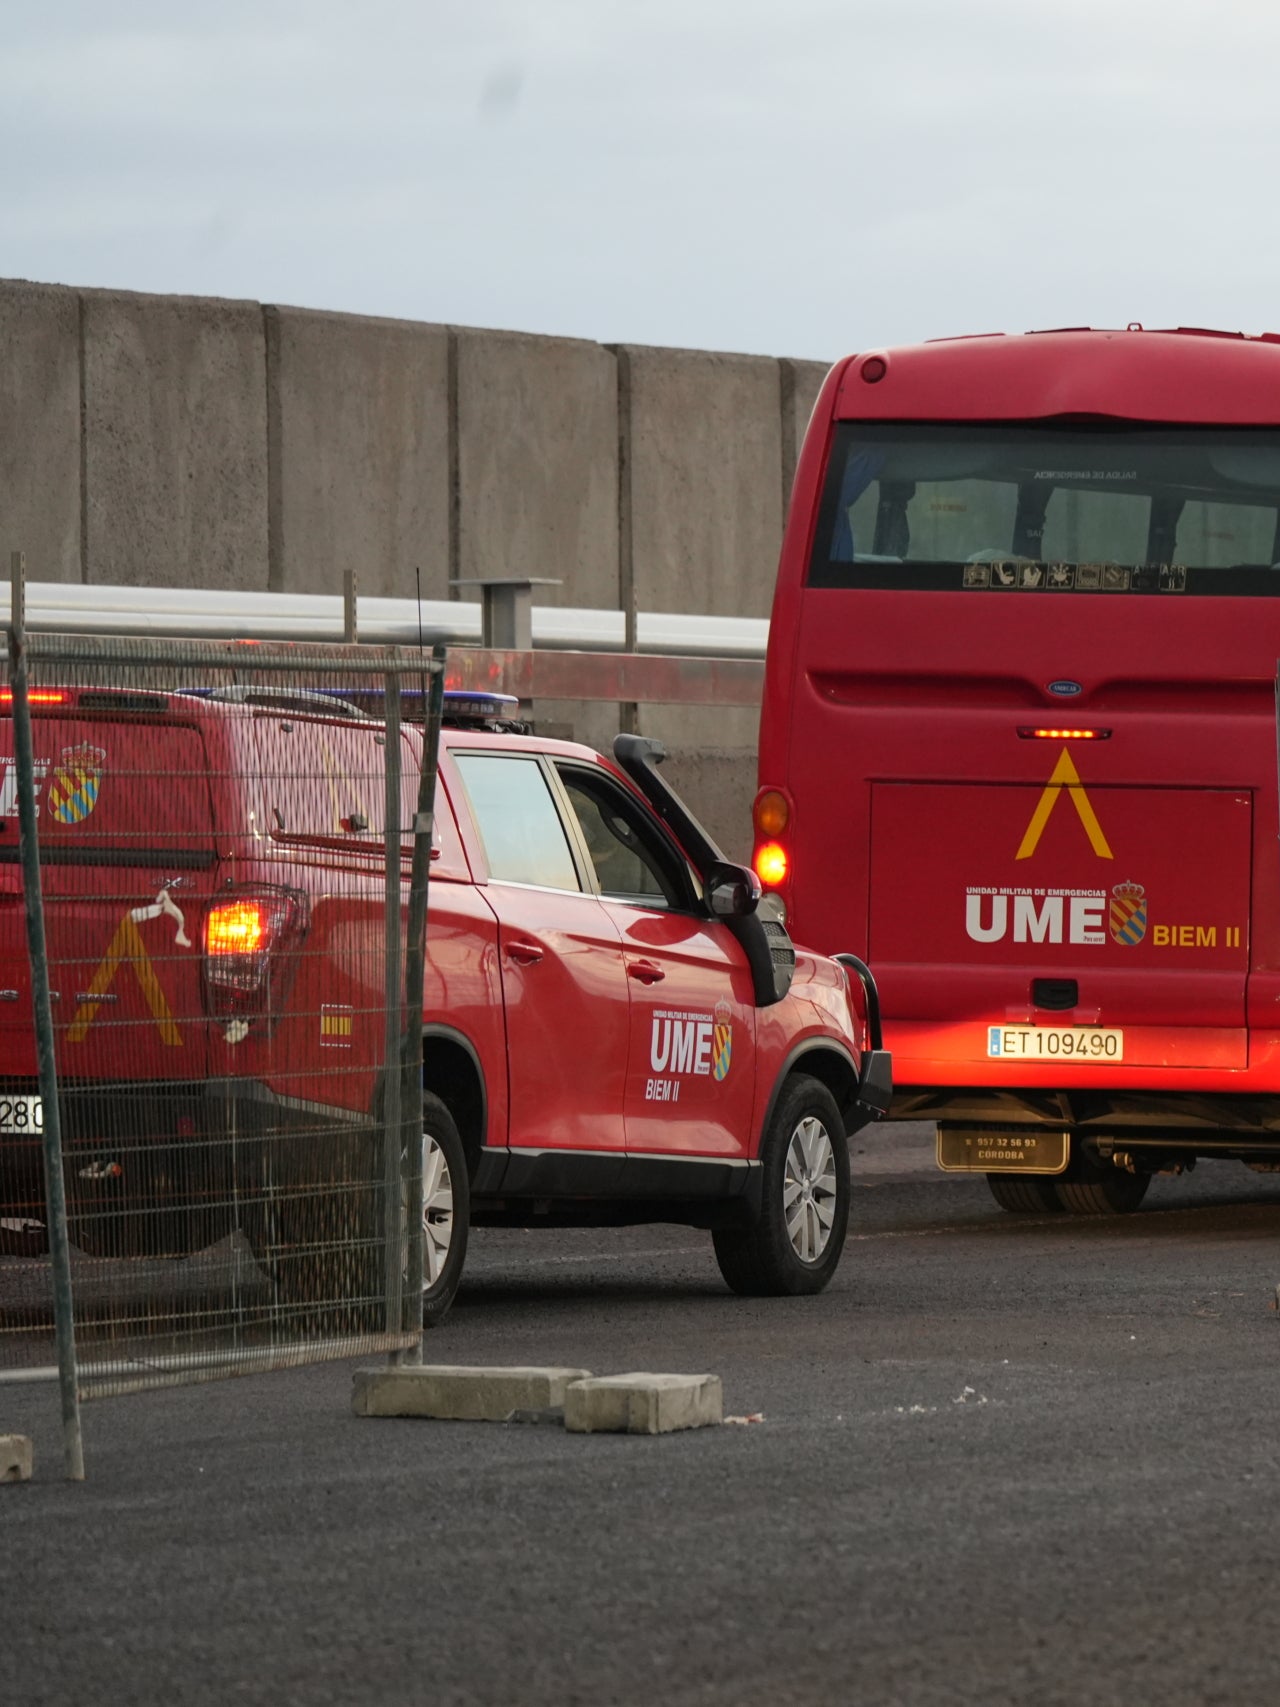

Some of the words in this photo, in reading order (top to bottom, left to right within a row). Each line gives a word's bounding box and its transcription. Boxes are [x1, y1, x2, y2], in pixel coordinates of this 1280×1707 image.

[966, 887, 998, 895] UNIDAD
[999, 887, 1032, 896] MILITAR
[1034, 888, 1046, 896] DE
[1047, 888, 1107, 898] EMERGENCIAS
[965, 894, 1106, 945] UME
[1153, 925, 1217, 947] BIEM
[1226, 927, 1240, 948] II
[651, 1018, 713, 1075] UME
[1003, 1031, 1030, 1054] ET
[1036, 1032, 1118, 1056] 109490
[645, 1078, 672, 1101] BIEM
[672, 1080, 680, 1103] II
